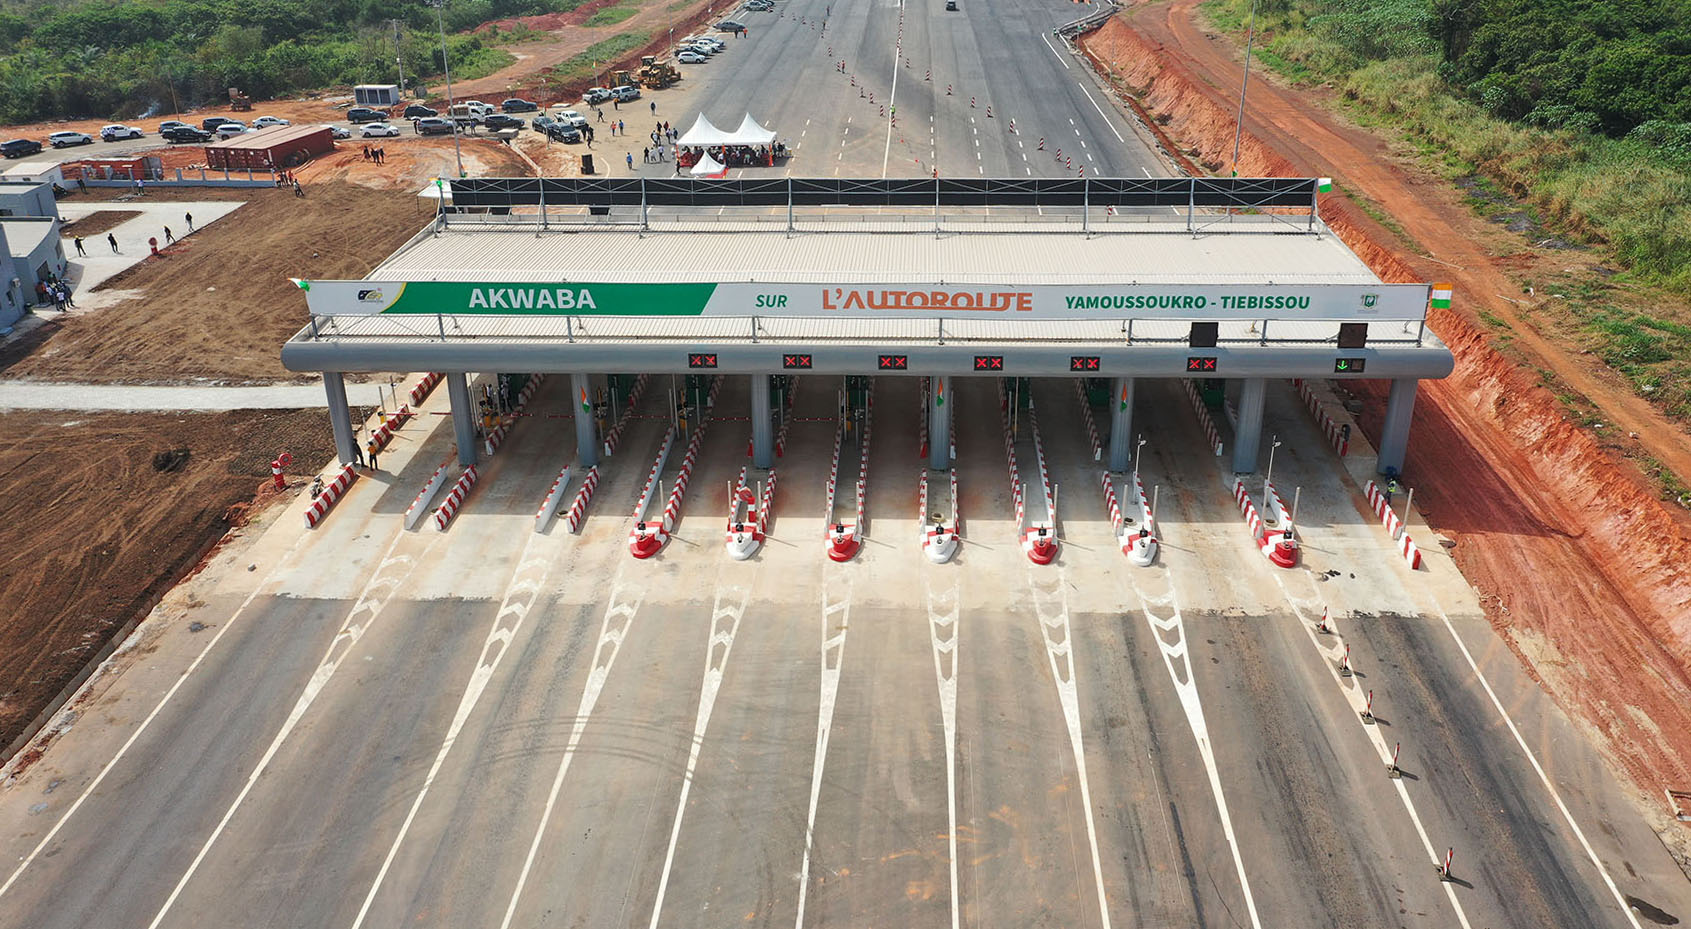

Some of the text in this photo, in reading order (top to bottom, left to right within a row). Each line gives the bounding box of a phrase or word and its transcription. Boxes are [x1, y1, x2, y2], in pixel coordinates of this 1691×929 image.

[468, 288, 597, 309] AKWABA
[755, 295, 789, 309] SUR
[1065, 295, 1208, 310] YAMOUSSOUKRO
[1221, 296, 1311, 310] TIEBISSOU
